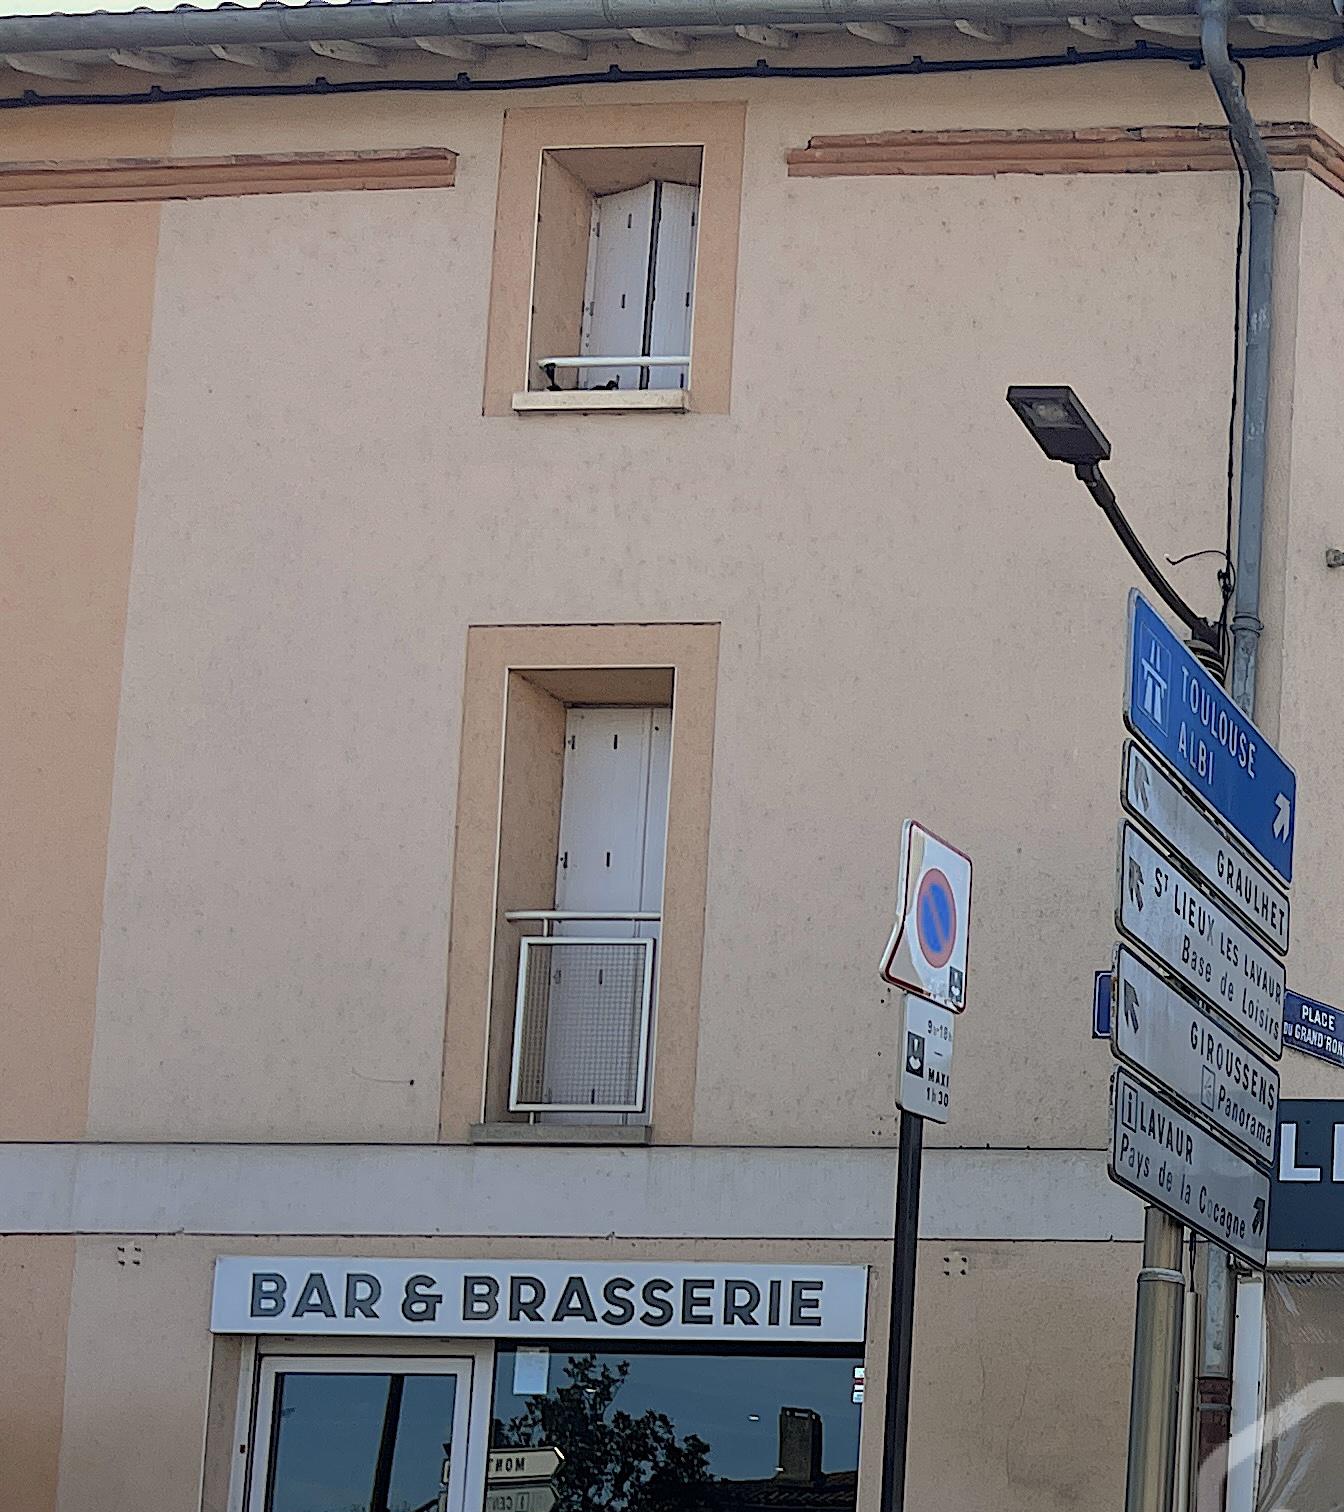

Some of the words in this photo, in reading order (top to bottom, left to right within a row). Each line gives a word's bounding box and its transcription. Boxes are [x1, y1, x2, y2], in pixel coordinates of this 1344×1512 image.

[1178, 721, 1214, 785] ALBI
[1182, 665, 1256, 779] TOULOUSE
[1216, 849, 1285, 936] GRAULHET
[1174, 884, 1215, 946] LIEUX
[1220, 932, 1239, 966] LES
[1244, 954, 1282, 1005] LAVAUR
[1181, 934, 1212, 983] Base
[1220, 972, 1234, 1002] de
[1241, 987, 1280, 1041] Loisirs
[1302, 1004, 1336, 1032] PLACE
[1283, 1021, 1294, 1037] DU
[926, 1087, 949, 1107] 1h30
[927, 1067, 950, 1088] MAXI
[1190, 1021, 1275, 1111] GIROUSSENS
[1140, 1101, 1193, 1165] LAVAUR
[1217, 1084, 1272, 1147] Panorama
[1120, 1133, 1150, 1179] Pays
[1158, 1161, 1173, 1193] de
[1180, 1174, 1192, 1205] la
[1199, 1186, 1246, 1240] Cocagne
[249, 1271, 383, 1319] BAR
[400, 1274, 443, 1323] &
[462, 1275, 825, 1328] BRASSERIE
